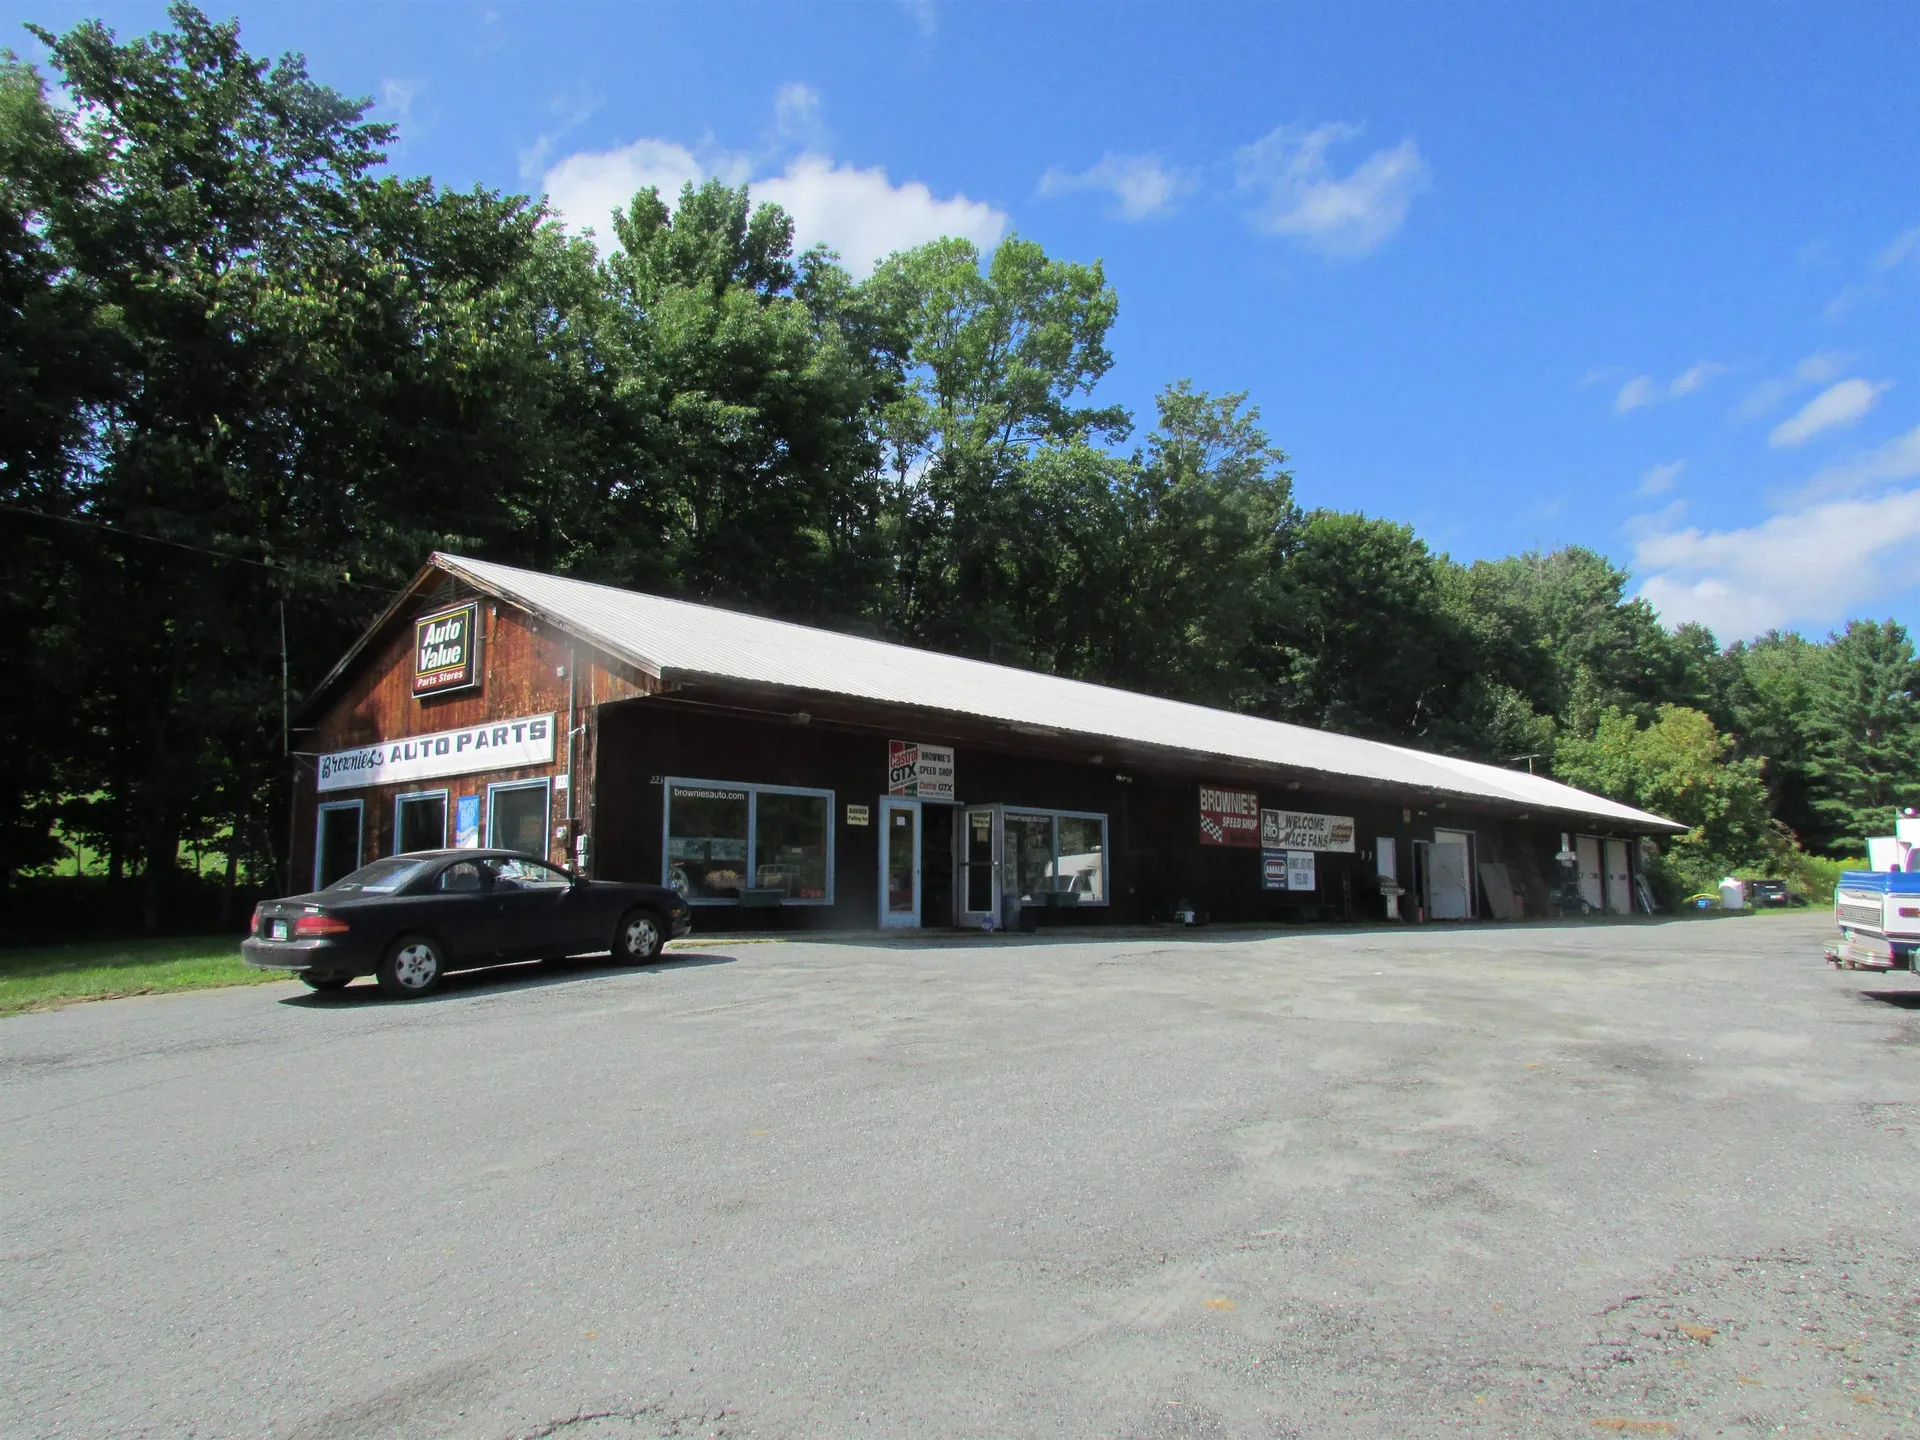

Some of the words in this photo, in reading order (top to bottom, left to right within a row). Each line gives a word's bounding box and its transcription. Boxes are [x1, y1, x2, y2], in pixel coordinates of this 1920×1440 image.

[423, 618, 461, 648] Auto
[421, 643, 462, 671] Value
[417, 676, 437, 688] Parts
[439, 670, 463, 682] Stores
[390, 737, 450, 763] AUTO
[456, 719, 547, 753] PARTS
[321, 750, 385, 779] Brownie's
[890, 747, 919, 769] Castrol
[921, 752, 951, 763] BROWNIE'S
[890, 760, 917, 783] GTX
[919, 765, 937, 776] SPEED
[938, 767, 953, 777] SHOP
[650, 775, 664, 785] 223
[938, 783, 953, 792] GTX
[674, 788, 745, 800] browniesauto.com
[1200, 788, 1257, 816] BROWNIE'S
[1222, 816, 1241, 828] SPEED
[1242, 818, 1258, 829] SHOP
[1285, 814, 1325, 831] WELCOME
[1264, 825, 1278, 838] PRO
[1285, 832, 1307, 847] RACE
[1307, 833, 1329, 848] FANS
